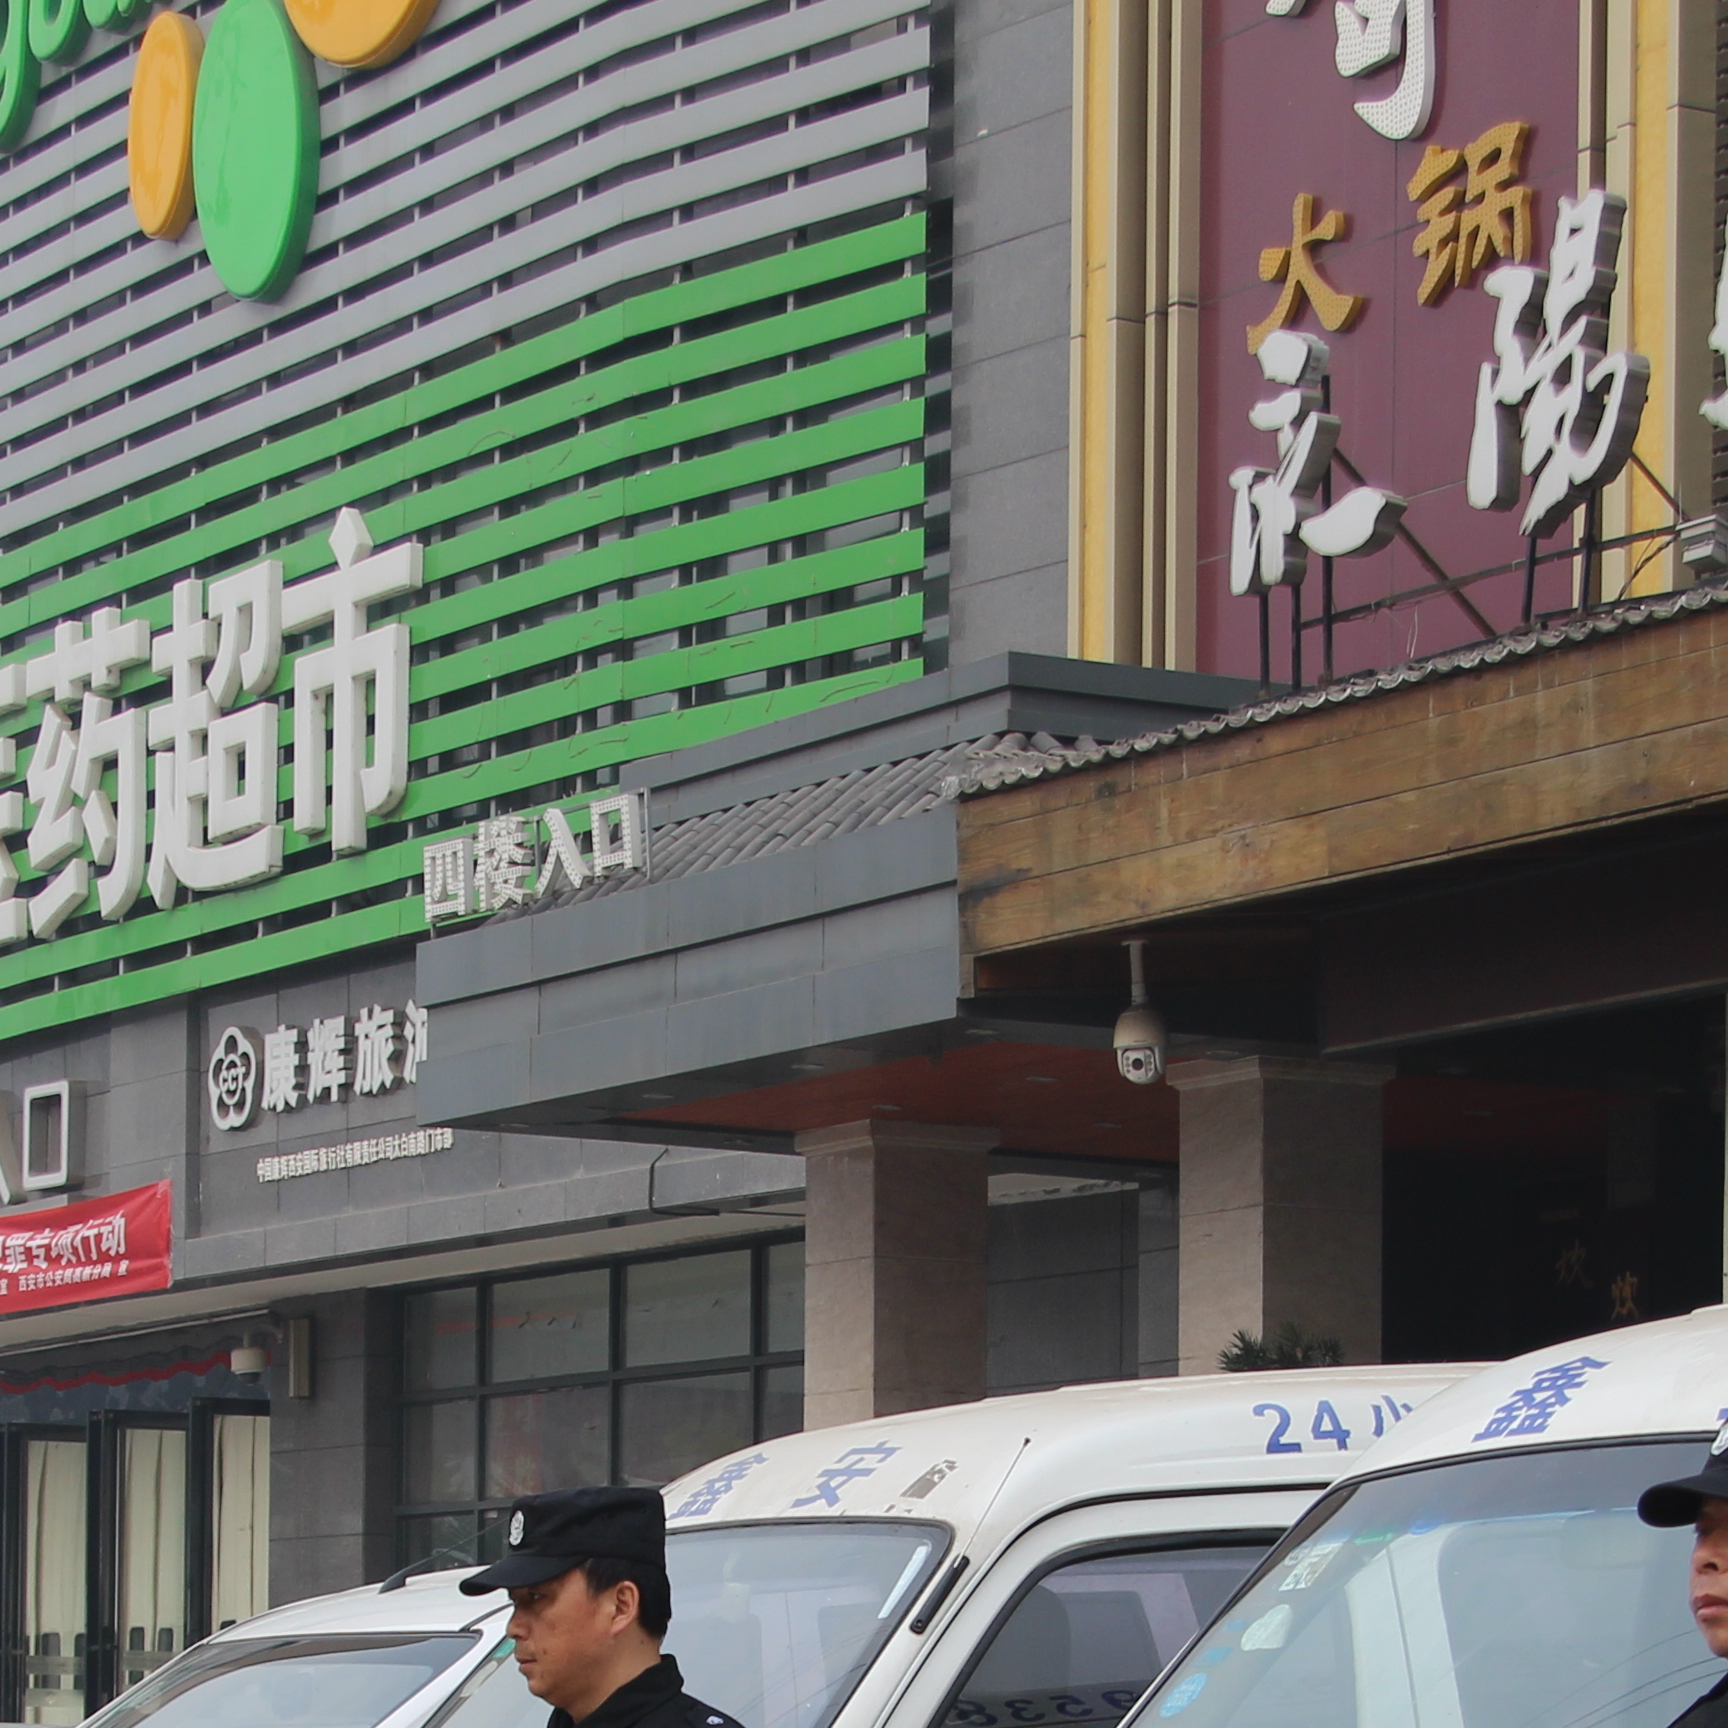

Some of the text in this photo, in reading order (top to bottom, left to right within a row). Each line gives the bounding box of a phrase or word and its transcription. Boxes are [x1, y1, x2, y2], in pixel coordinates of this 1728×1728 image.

[1247, 121, 1532, 355] 火锅
[423, 794, 642, 922] 四楼入口
